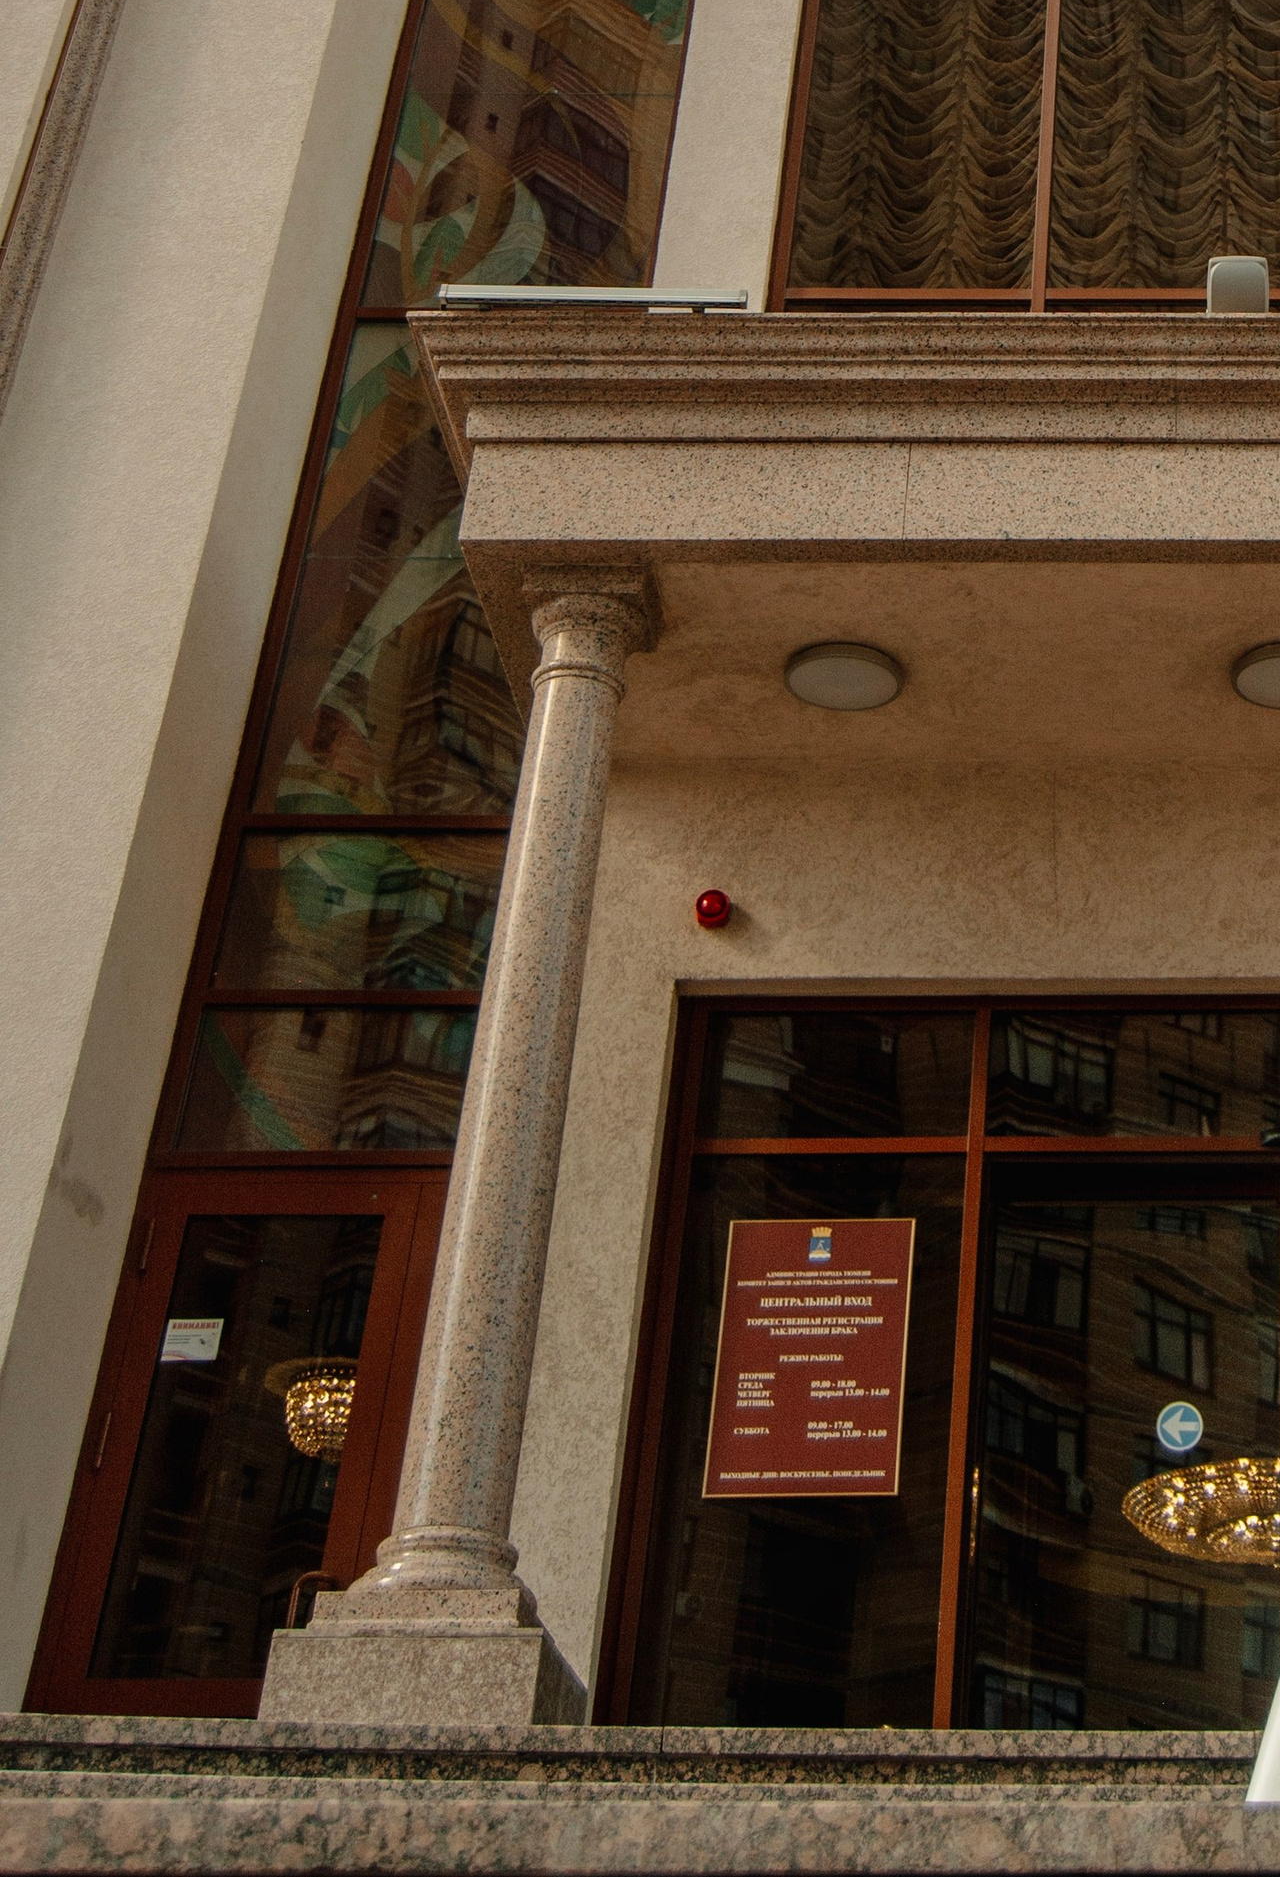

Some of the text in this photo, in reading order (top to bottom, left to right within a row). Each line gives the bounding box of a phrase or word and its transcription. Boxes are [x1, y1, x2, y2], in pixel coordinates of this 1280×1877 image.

[760, 1295, 872, 1307] ЦЕНТРАЛЬНЫЙ ВХОД
[746, 1317, 883, 1326] ТОРЖЕСТВЕННАЯ РЕГИСТРАЦИЯ
[770, 1328, 830, 1336] ЗАКЛЮЧЕНИЯ
[837, 1380, 856, 1388] 18.00
[811, 1390, 843, 1399] перерыв
[834, 1421, 853, 1429] 17.00
